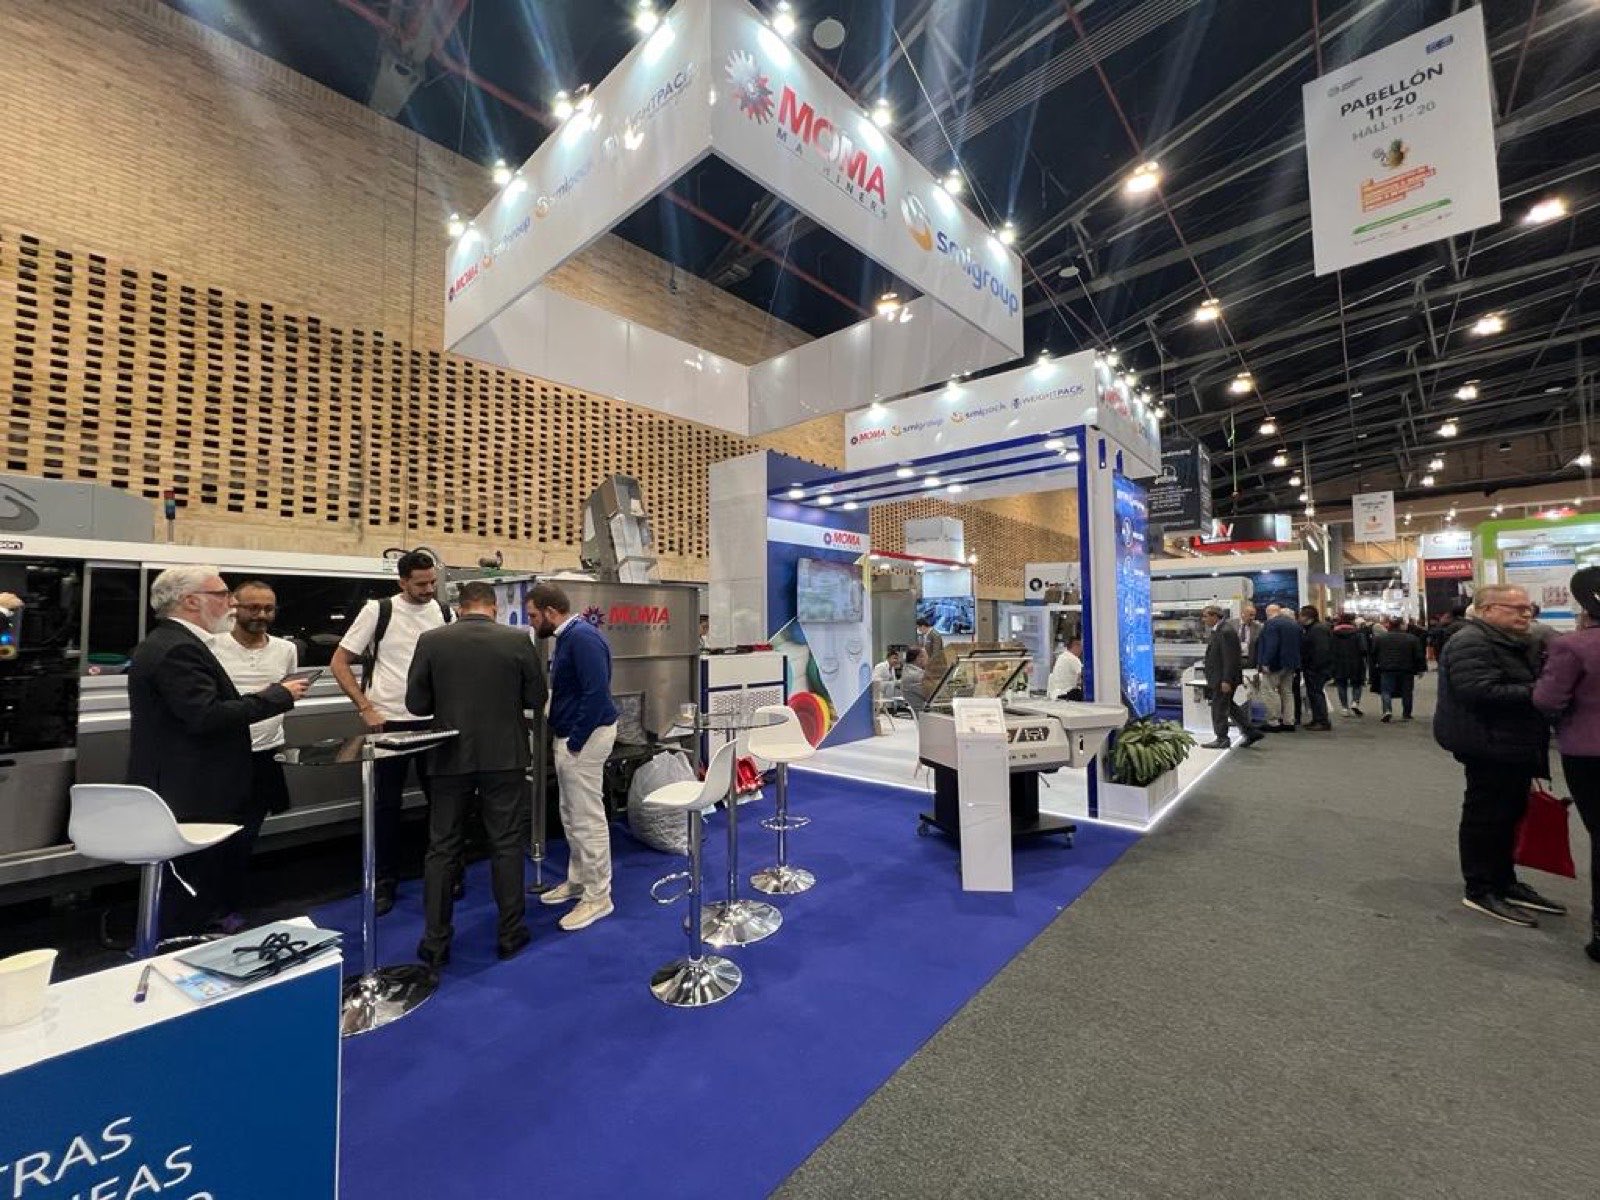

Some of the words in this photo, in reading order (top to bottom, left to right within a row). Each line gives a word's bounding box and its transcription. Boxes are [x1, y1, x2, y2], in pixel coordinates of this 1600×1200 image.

[1341, 62, 1443, 117] PABELLÓN
[1366, 91, 1417, 120] 11-20
[777, 85, 886, 203] MOMA
[936, 230, 1019, 317] smigroup
[832, 530, 861, 547] MOMA
[608, 606, 670, 625] MOMA
